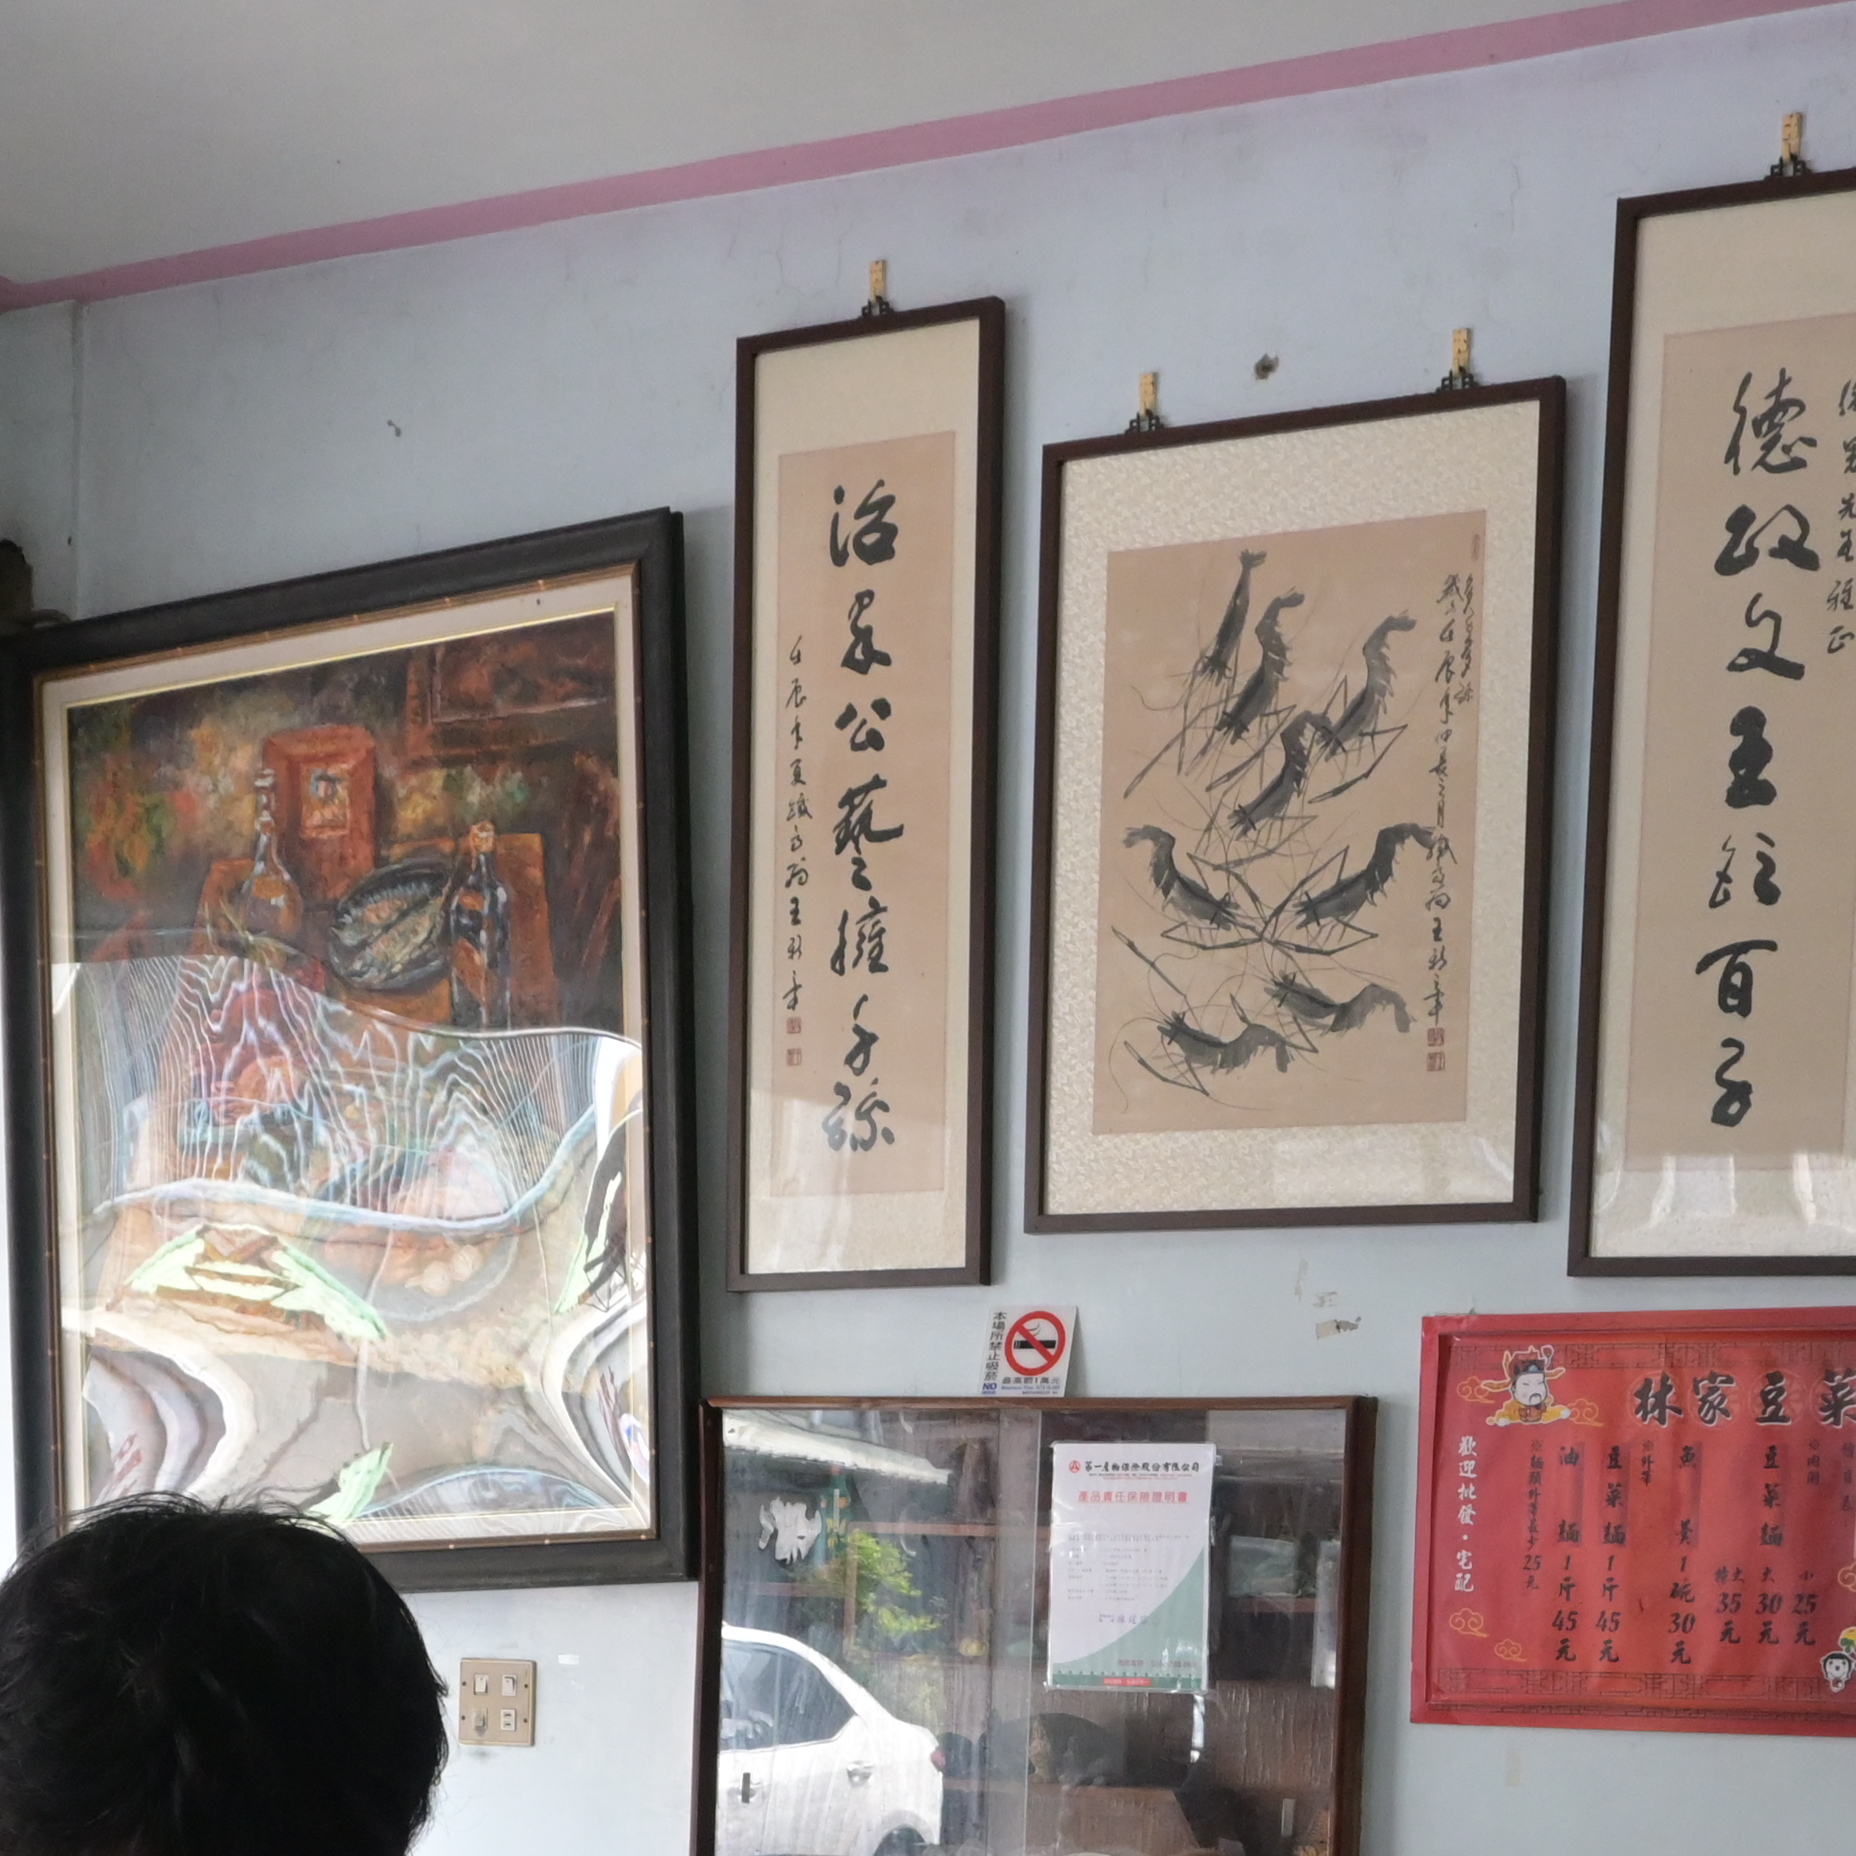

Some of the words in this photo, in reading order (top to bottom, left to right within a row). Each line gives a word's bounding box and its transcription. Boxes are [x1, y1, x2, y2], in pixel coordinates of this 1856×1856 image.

[984, 1311, 1007, 1381] 本場所禁止吸菸
[982, 1382, 997, 1390] NO
